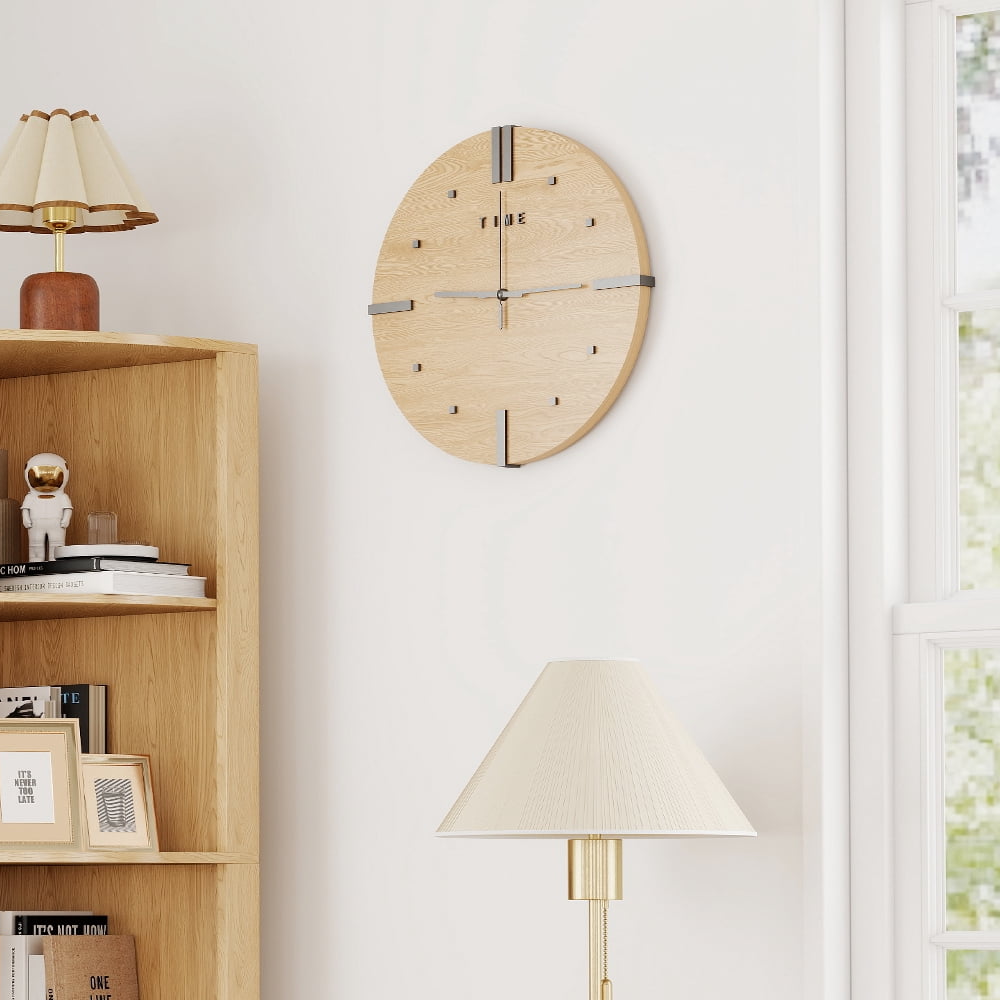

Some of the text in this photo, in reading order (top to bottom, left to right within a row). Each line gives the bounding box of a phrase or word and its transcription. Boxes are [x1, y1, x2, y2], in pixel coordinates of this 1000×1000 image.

[479, 212, 526, 229] TIME
[7, 565, 26, 575] HOM
[18, 770, 32, 779] IT'S
[14, 778, 37, 787] NEVER
[18, 787, 34, 796] TOO
[18, 795, 35, 804] LATE
[90, 975, 110, 990] ONE
